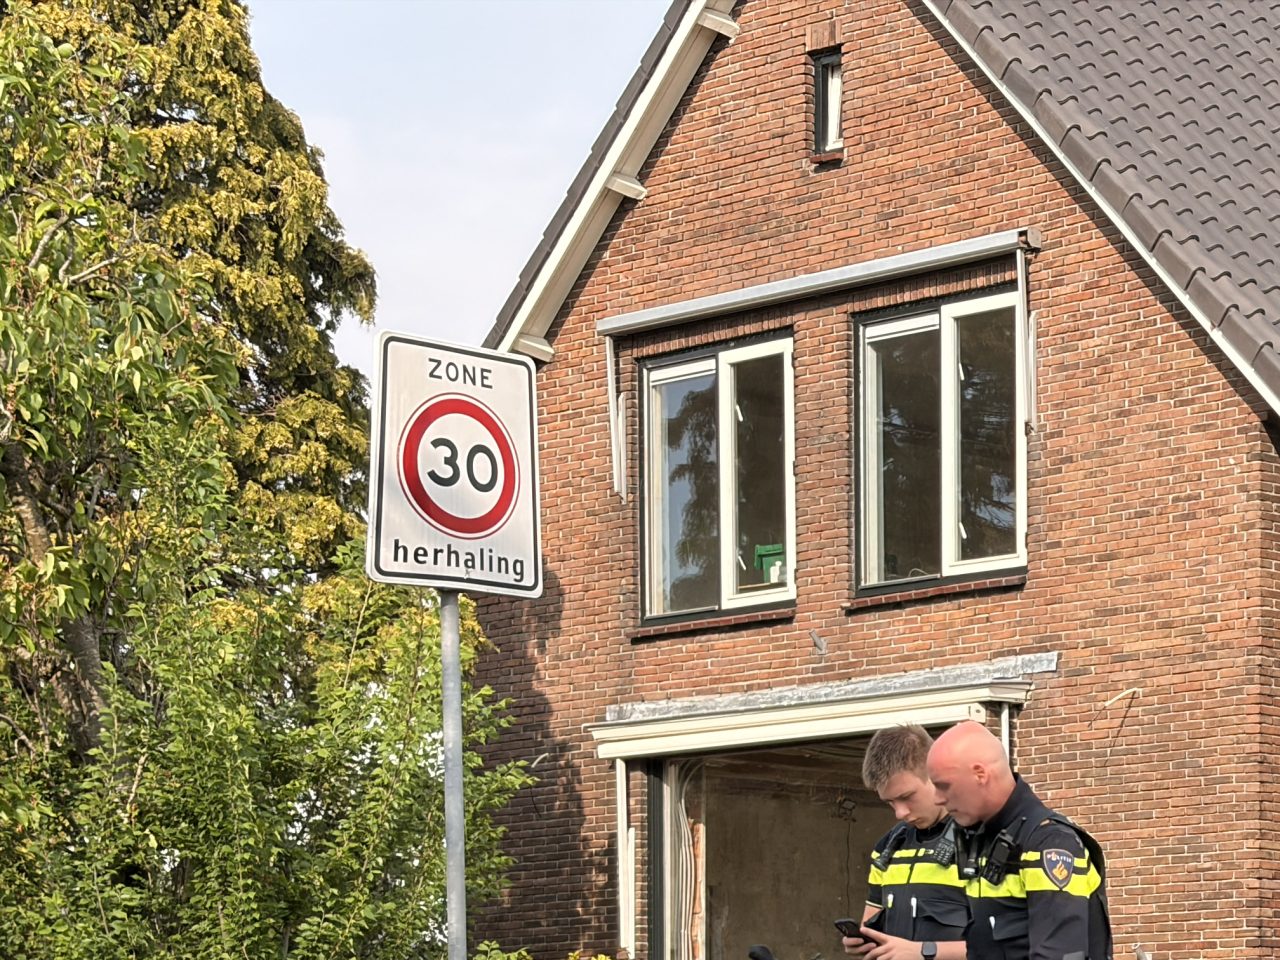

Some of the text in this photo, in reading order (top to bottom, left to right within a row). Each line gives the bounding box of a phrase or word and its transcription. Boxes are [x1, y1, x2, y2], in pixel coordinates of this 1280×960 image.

[428, 357, 493, 389] ZONE
[427, 437, 499, 493] 30
[393, 538, 525, 583] herhaling
